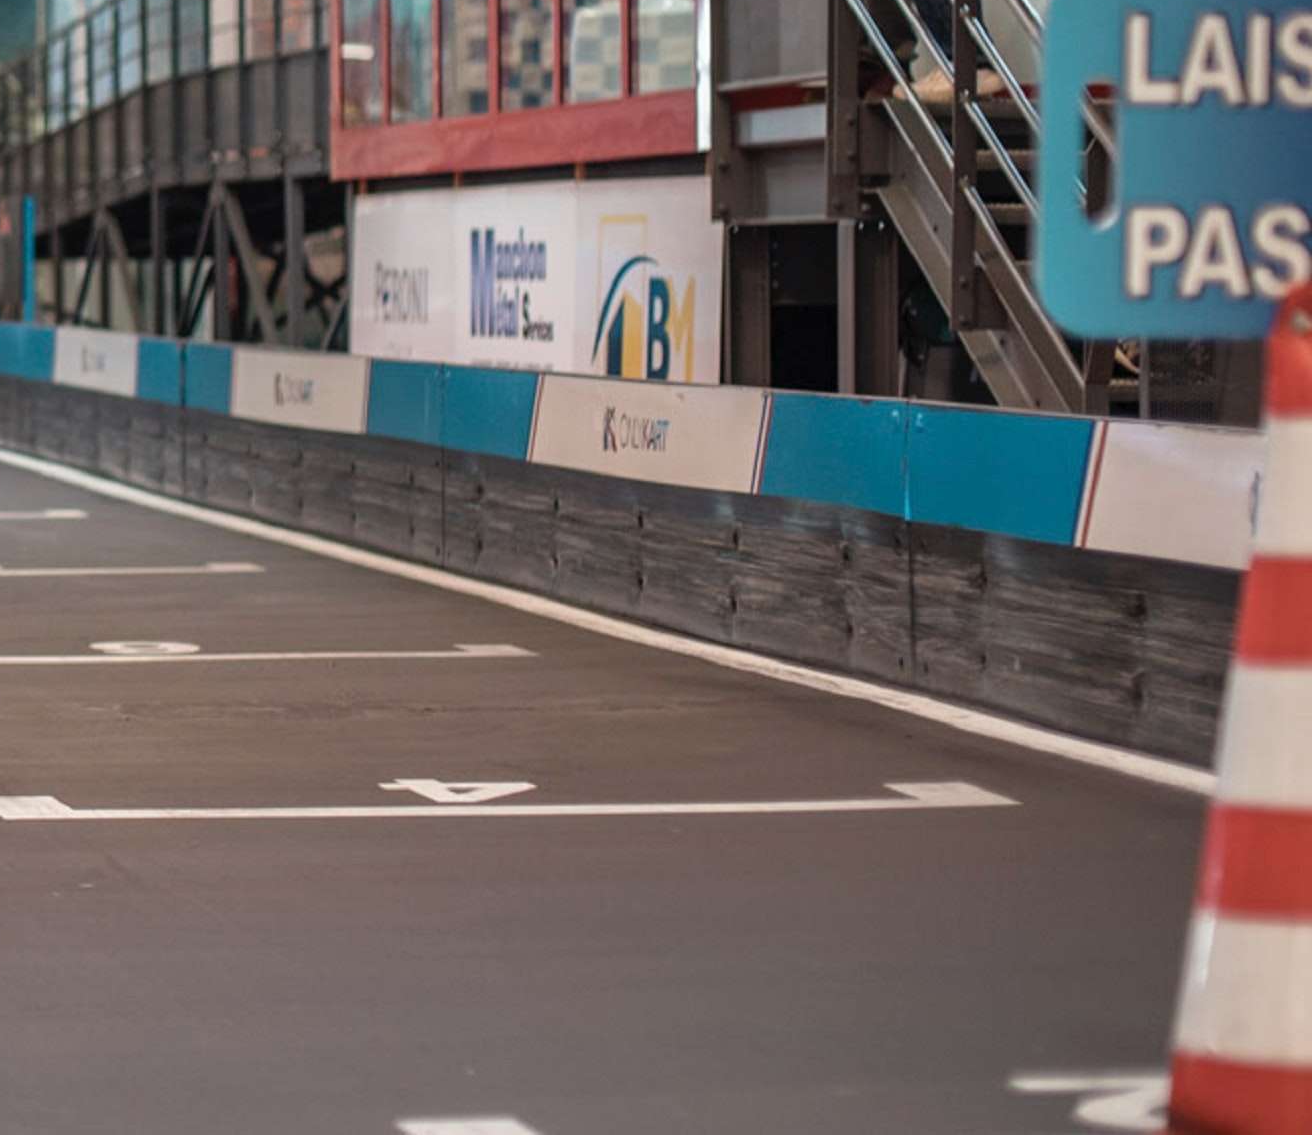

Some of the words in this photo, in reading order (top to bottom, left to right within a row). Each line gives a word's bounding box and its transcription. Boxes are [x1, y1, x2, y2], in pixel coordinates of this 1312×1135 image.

[1126, 12, 1312, 107] LAIS
[1126, 205, 1312, 299] PAS
[378, 778, 537, 803] 4
